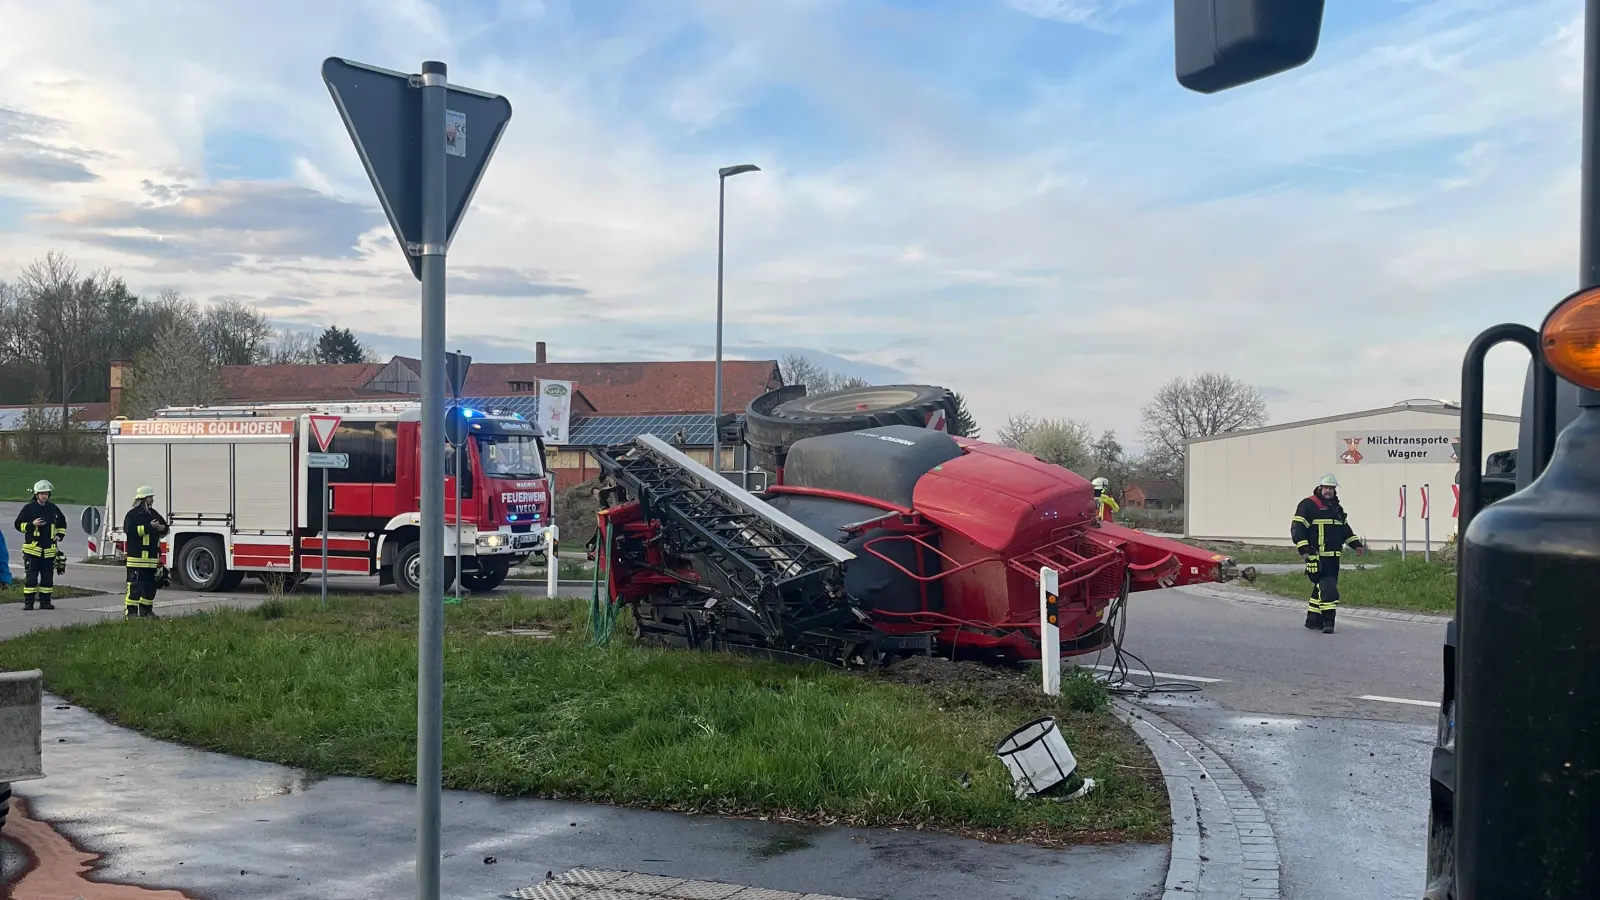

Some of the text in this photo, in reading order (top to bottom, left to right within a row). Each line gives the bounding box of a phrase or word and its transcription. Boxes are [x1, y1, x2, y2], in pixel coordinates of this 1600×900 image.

[131, 422, 282, 435] FEUERWEHR GOLLHOFEN
[1367, 436, 1449, 446] Milchtransporte
[1387, 449, 1428, 460] Wagner
[501, 491, 546, 503] FEUERWEHR
[515, 504, 537, 512] IVECO
